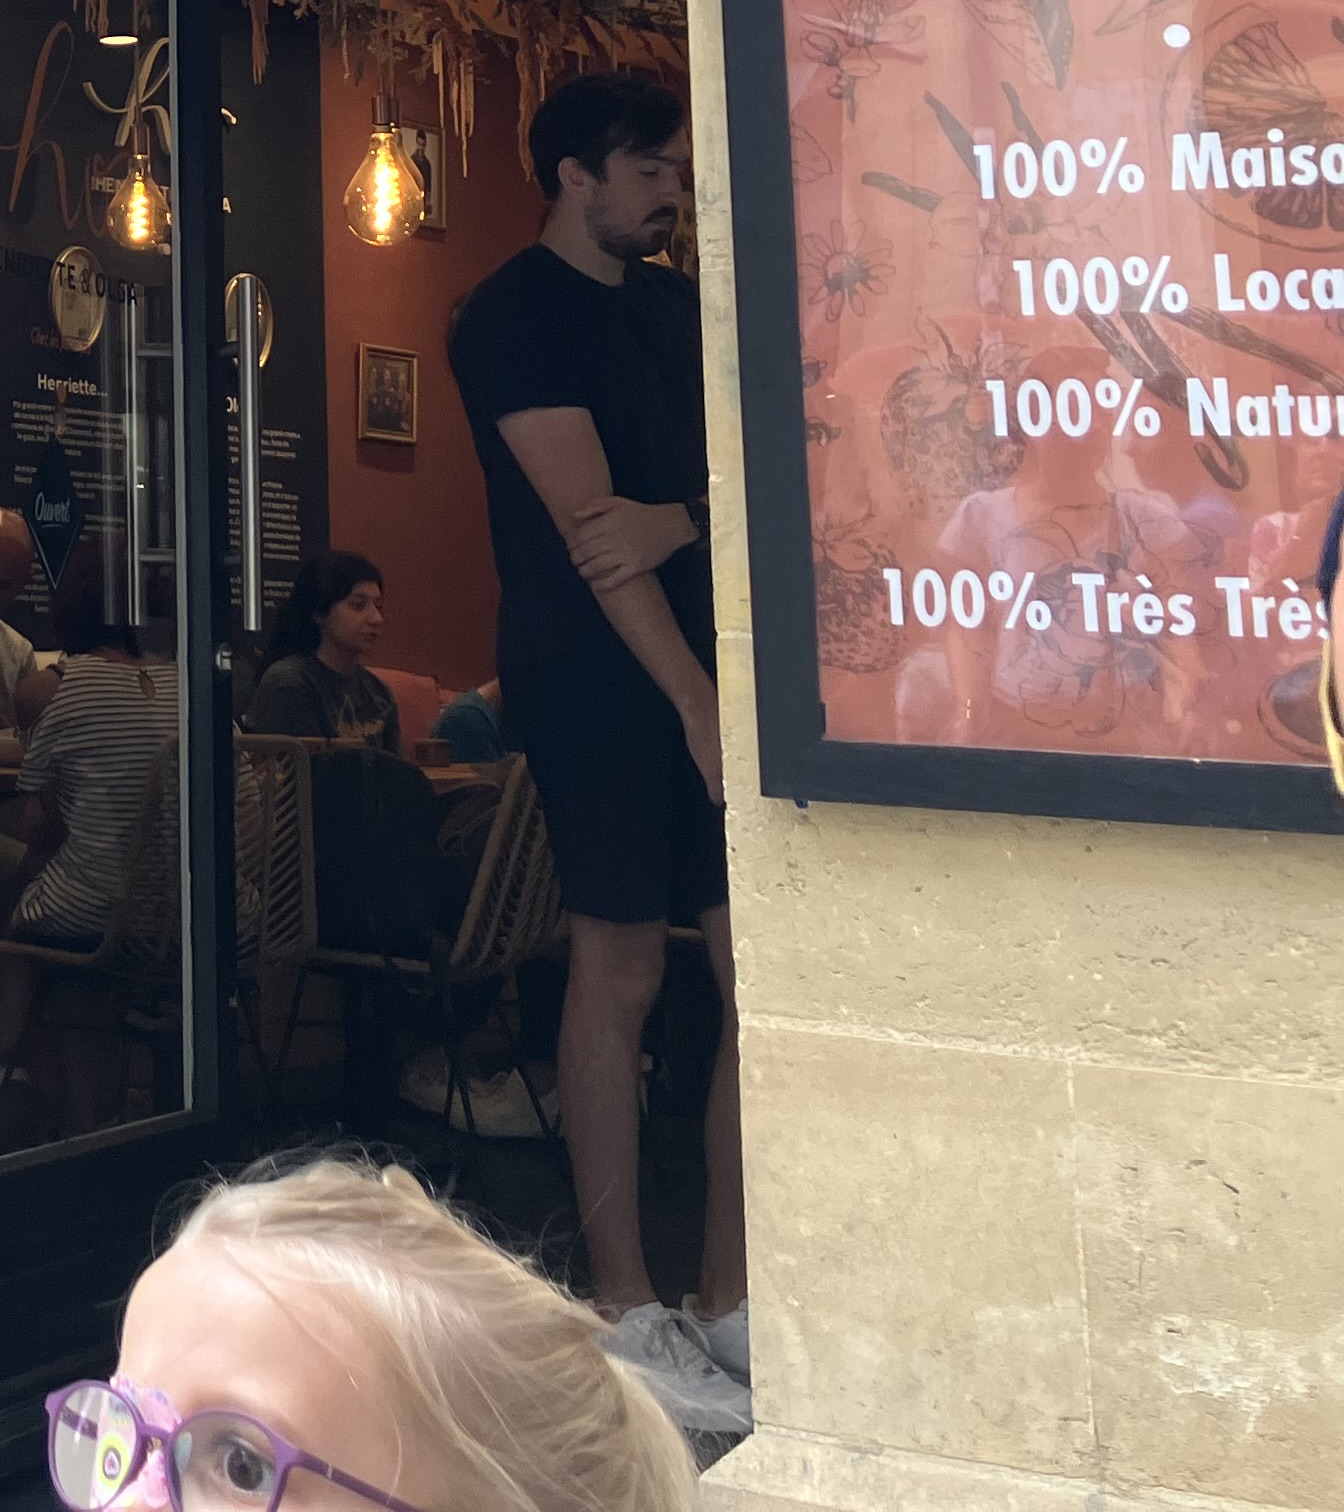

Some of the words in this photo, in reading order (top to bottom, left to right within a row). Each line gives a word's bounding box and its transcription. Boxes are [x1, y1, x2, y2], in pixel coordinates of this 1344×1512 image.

[973, 137, 1145, 200] 100%
[1012, 255, 1189, 316] 100%
[985, 378, 1161, 437] 100%
[1186, 377, 1344, 437] Natu
[35, 491, 71, 523] Ouvert
[882, 568, 1051, 631] 100%
[1071, 573, 1196, 636] Très
